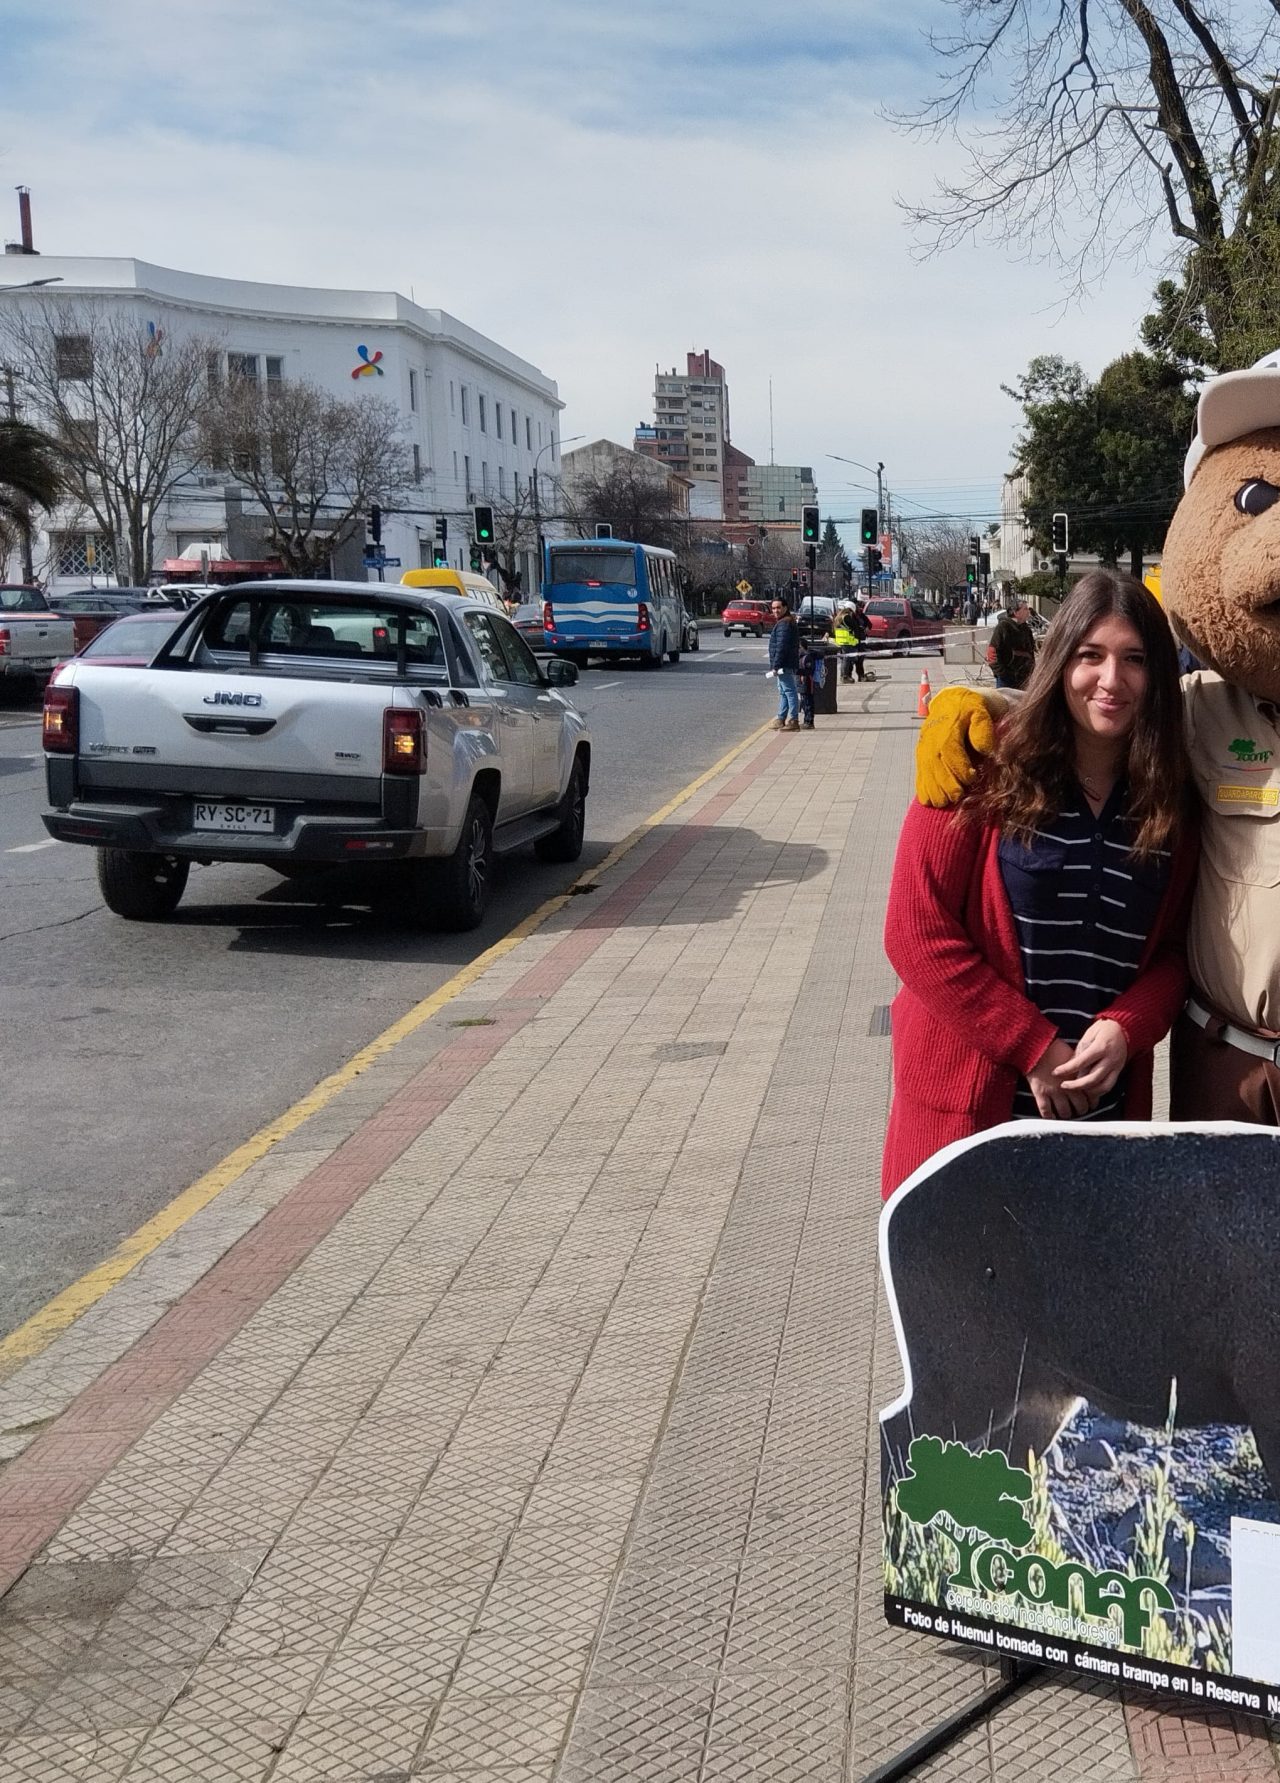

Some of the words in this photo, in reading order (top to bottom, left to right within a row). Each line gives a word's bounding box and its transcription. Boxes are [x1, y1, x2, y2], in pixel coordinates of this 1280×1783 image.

[946, 1590, 1018, 1620] corporación
[1019, 1607, 1073, 1632] nacional
[1074, 1619, 1121, 1645] forestal
[904, 1607, 932, 1629] Foto
[934, 1615, 949, 1634] de
[951, 1620, 994, 1646] Huemul
[996, 1632, 1042, 1657] tomada
[1045, 1645, 1068, 1664] con
[1075, 1650, 1120, 1676] cámara
[1123, 1663, 1169, 1693] trampa
[1171, 1678, 1188, 1694] en
[1192, 1678, 1203, 1696] la
[1206, 1681, 1260, 1709] Reserva
